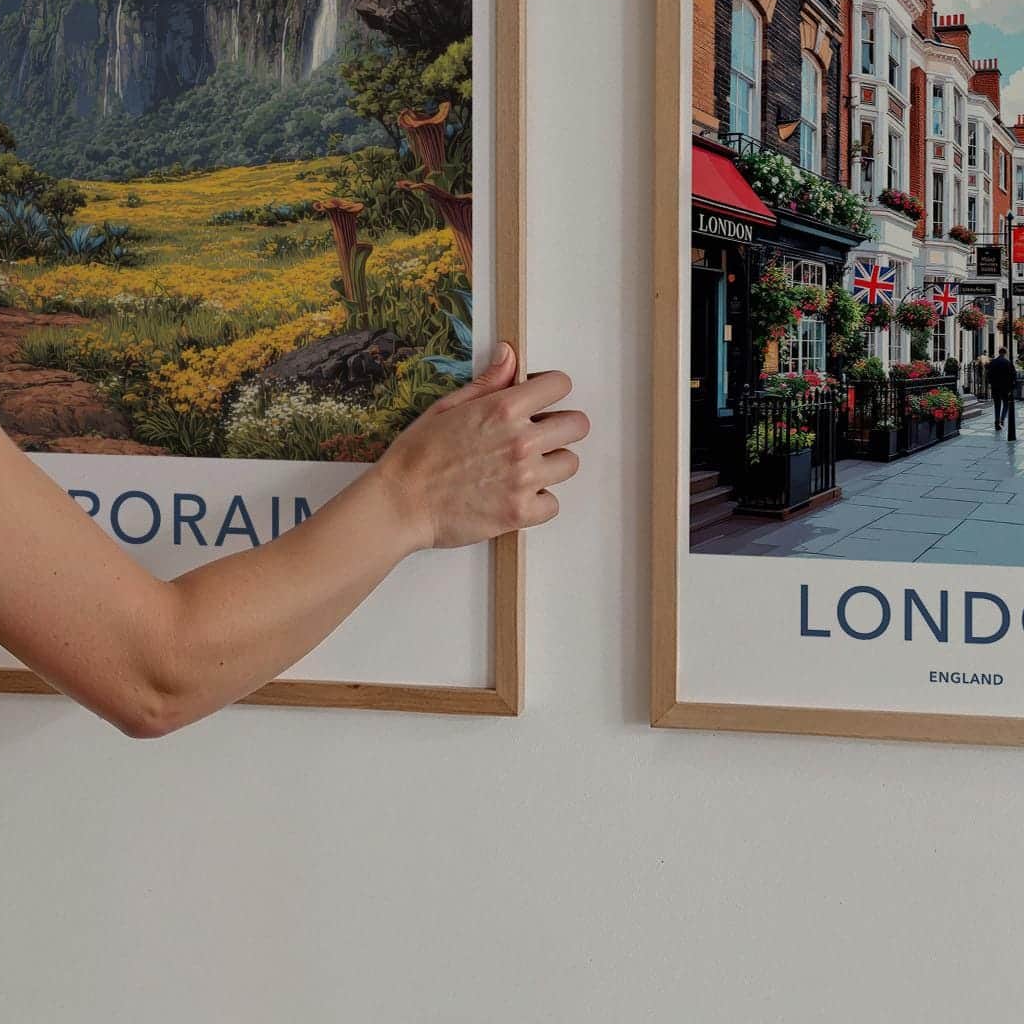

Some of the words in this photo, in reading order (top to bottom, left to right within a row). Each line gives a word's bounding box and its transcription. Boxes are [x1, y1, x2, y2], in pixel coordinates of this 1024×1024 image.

[698, 213, 753, 242] LONDON
[800, 584, 1024, 645] LOND
[929, 671, 1004, 686] ENGLAND
